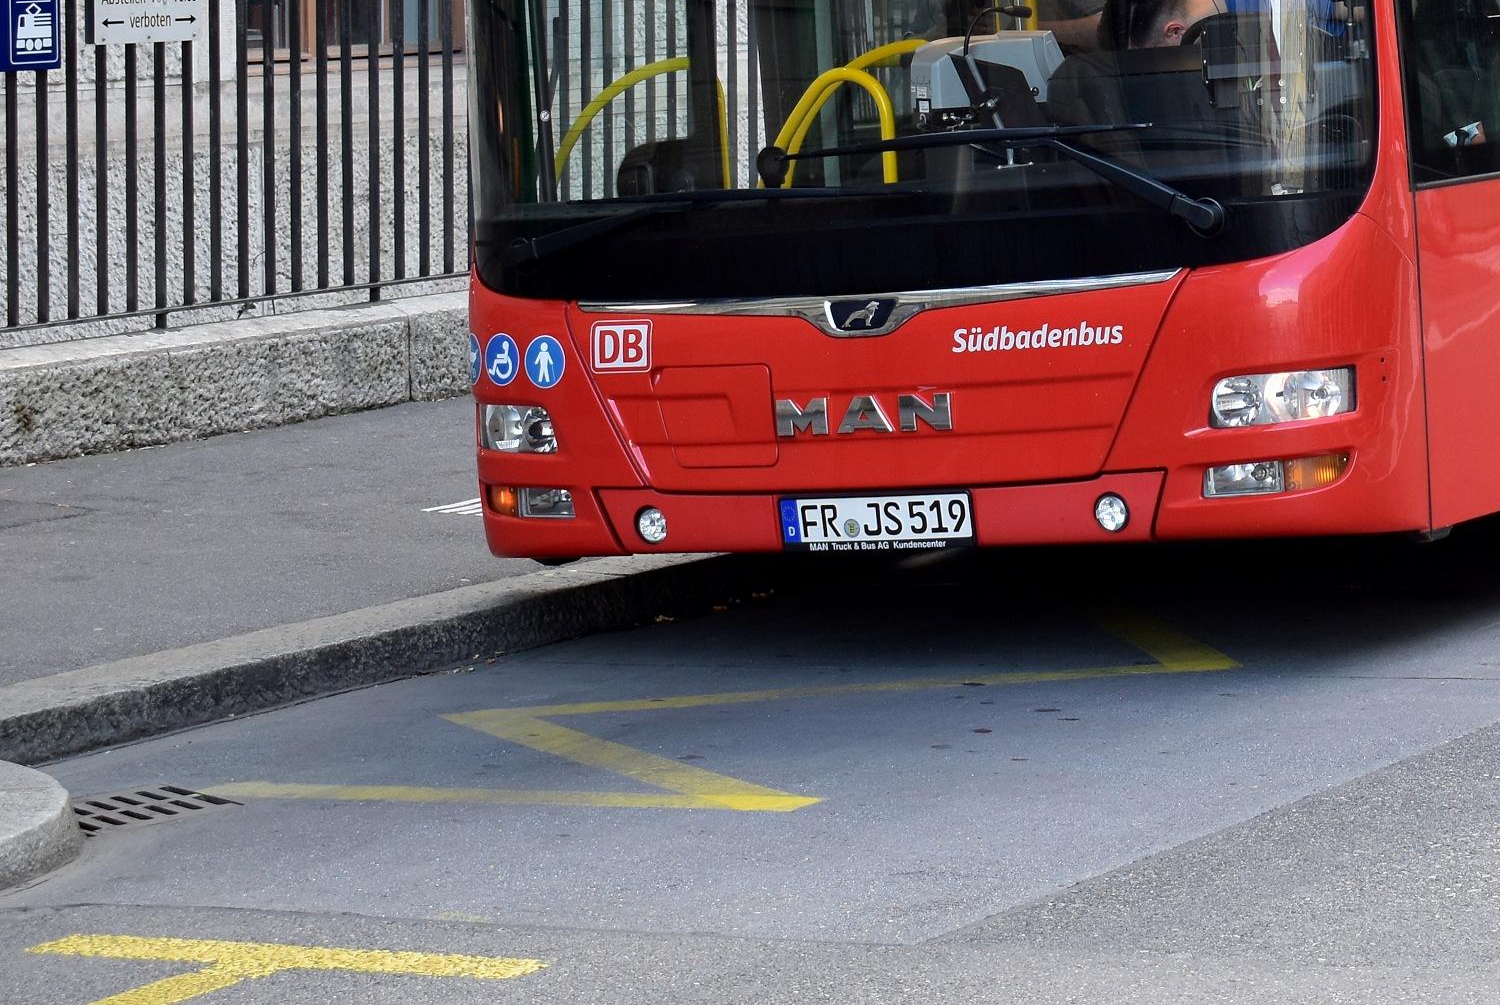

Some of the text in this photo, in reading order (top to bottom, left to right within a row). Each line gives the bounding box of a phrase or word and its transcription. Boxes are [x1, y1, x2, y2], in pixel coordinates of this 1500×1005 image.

[129, 11, 172, 28] verboten
[599, 328, 644, 364] DB
[952, 320, 1123, 353] Südbadenbus
[775, 392, 953, 437] MAN
[788, 526, 796, 537] D
[800, 504, 842, 538] FR
[809, 539, 947, 552] MAN Truck & Bus AG Kundencenter
